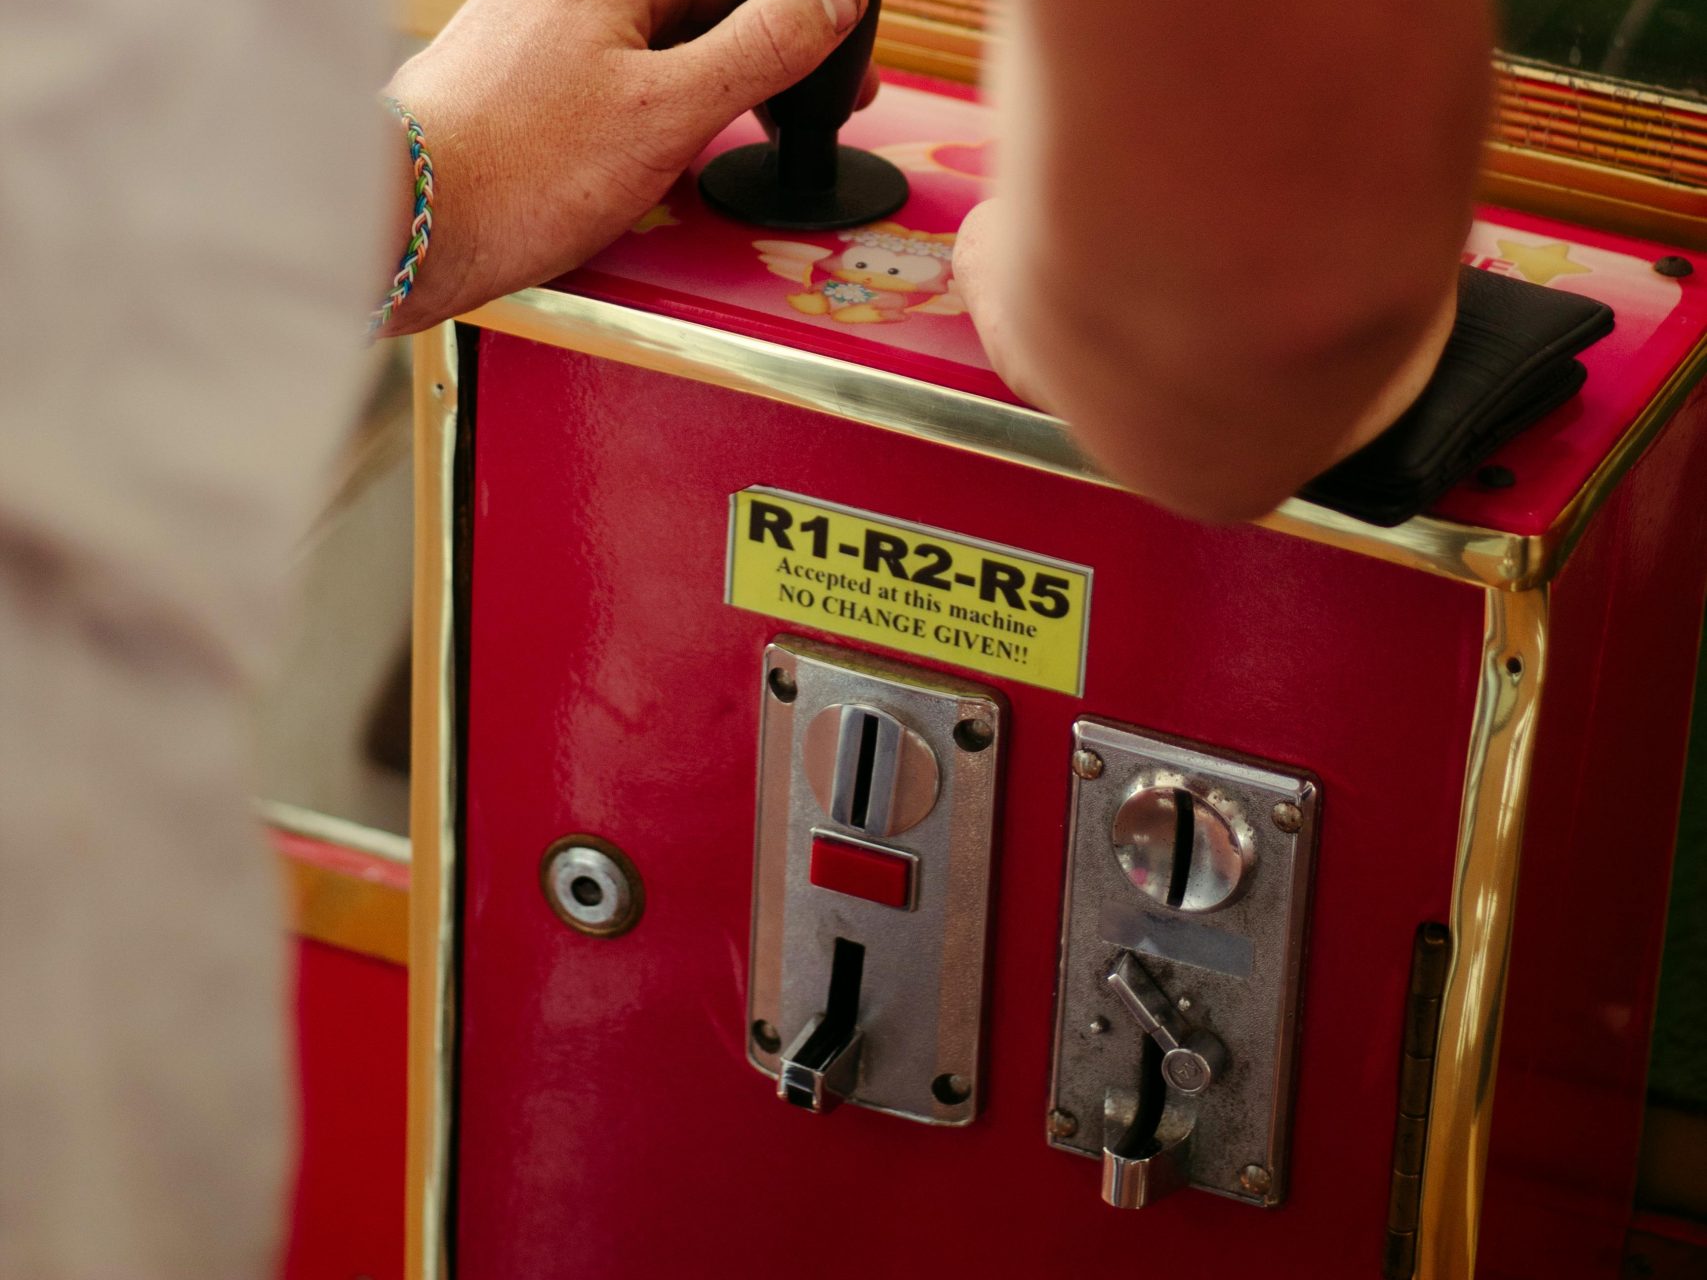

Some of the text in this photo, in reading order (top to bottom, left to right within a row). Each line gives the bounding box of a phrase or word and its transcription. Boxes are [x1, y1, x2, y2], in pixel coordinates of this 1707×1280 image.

[749, 499, 1070, 619] R1-R2-R5
[777, 557, 1037, 638] Accepted at this machine
[779, 584, 1028, 664] NO CHANGE GIVEN!!
